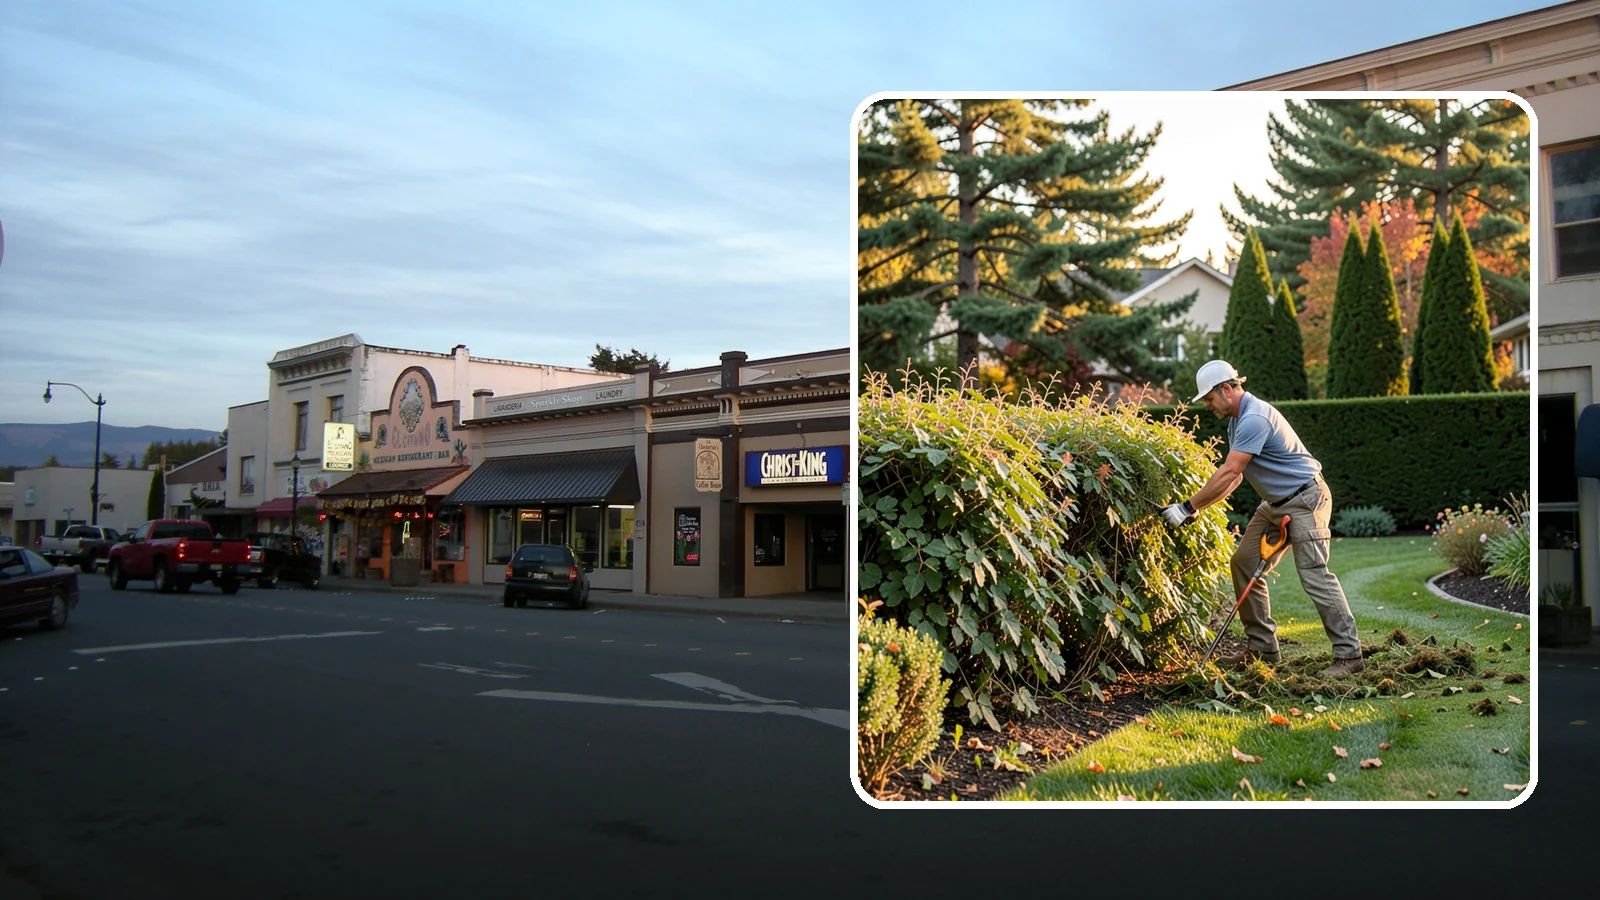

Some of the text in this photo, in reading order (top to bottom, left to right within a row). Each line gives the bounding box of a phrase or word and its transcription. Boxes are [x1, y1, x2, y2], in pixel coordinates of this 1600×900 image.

[562, 394, 582, 404] Shop
[596, 389, 623, 399] LAUNDRY
[493, 402, 523, 413] LAVANDERIA
[397, 451, 433, 462] RESTAURANT
[437, 450, 450, 459] BAR
[761, 450, 827, 478] CHRIST KING
